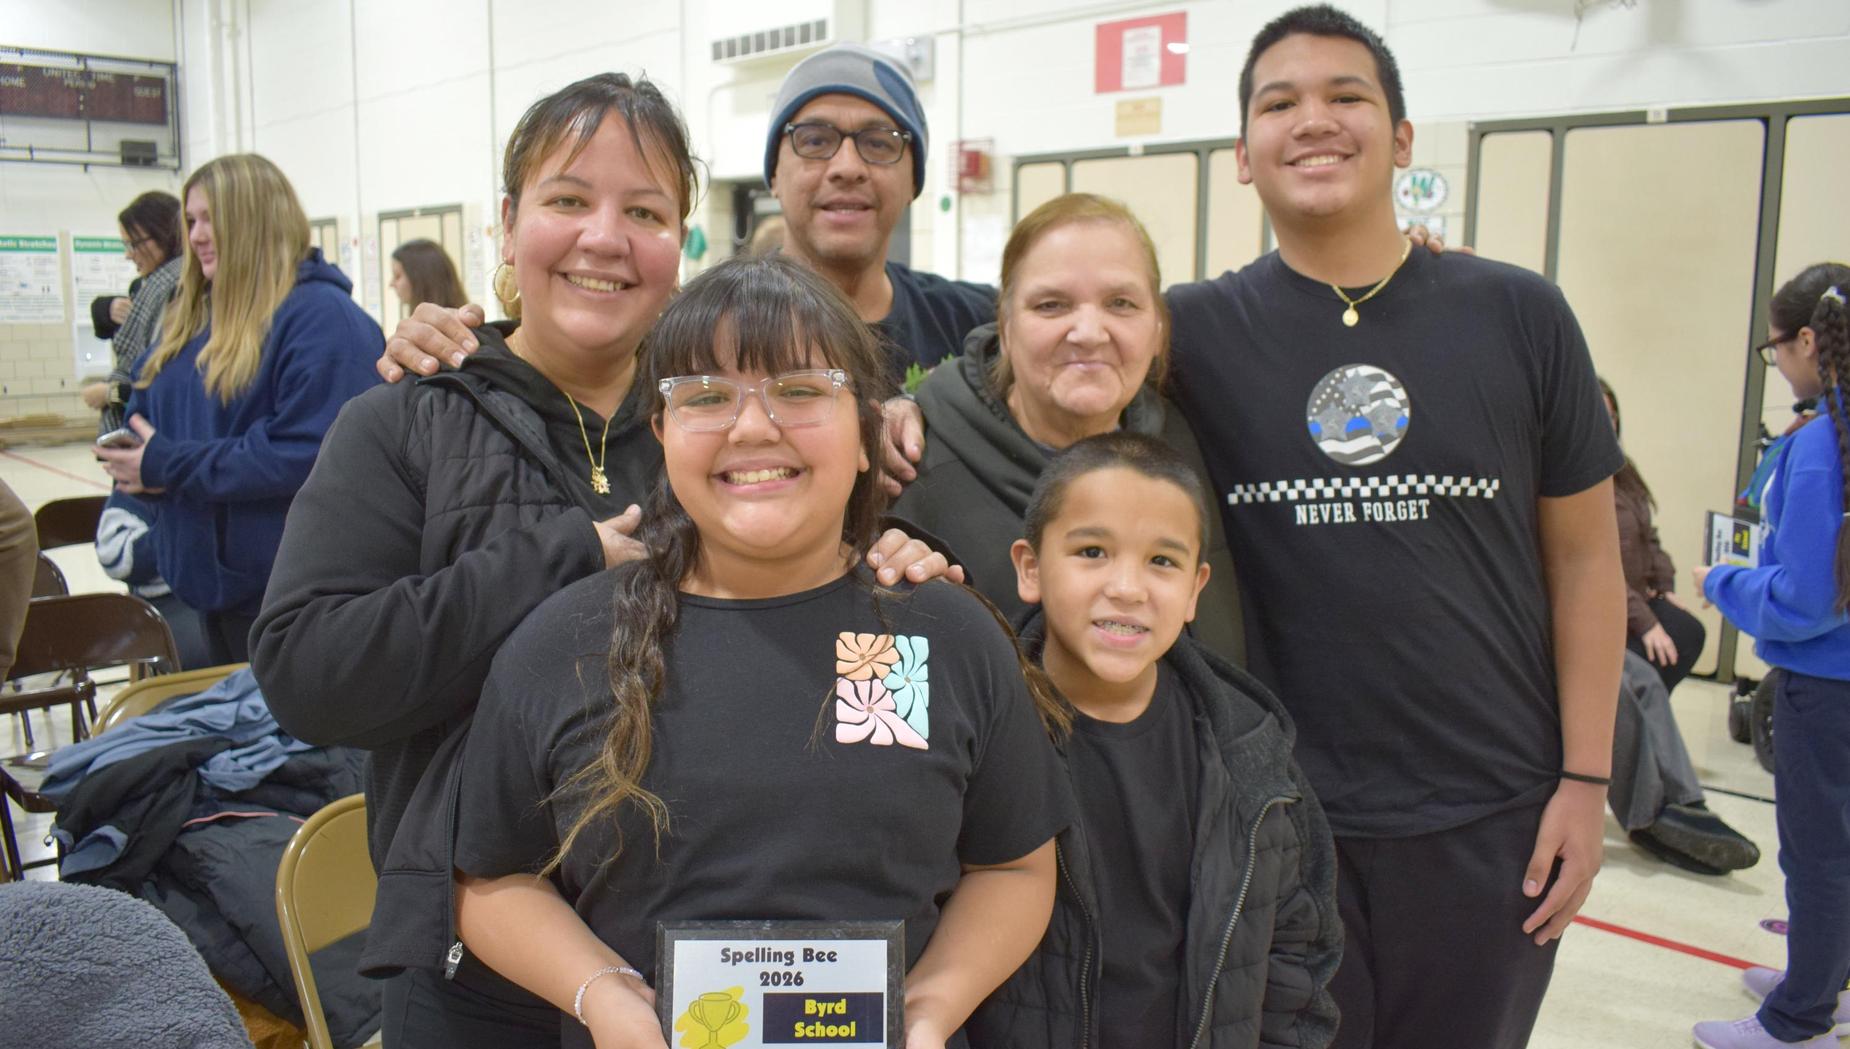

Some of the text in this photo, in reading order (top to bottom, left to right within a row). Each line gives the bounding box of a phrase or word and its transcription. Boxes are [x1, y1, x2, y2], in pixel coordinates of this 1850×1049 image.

[64, 78, 96, 90] PERID
[134, 86, 161, 98] GUEST
[1295, 499, 1430, 525] NEVER FORGET
[720, 947, 838, 966] Spelling Bee
[759, 971, 804, 987] 2026
[804, 998, 847, 1017] Byrd
[794, 1021, 856, 1038] School
